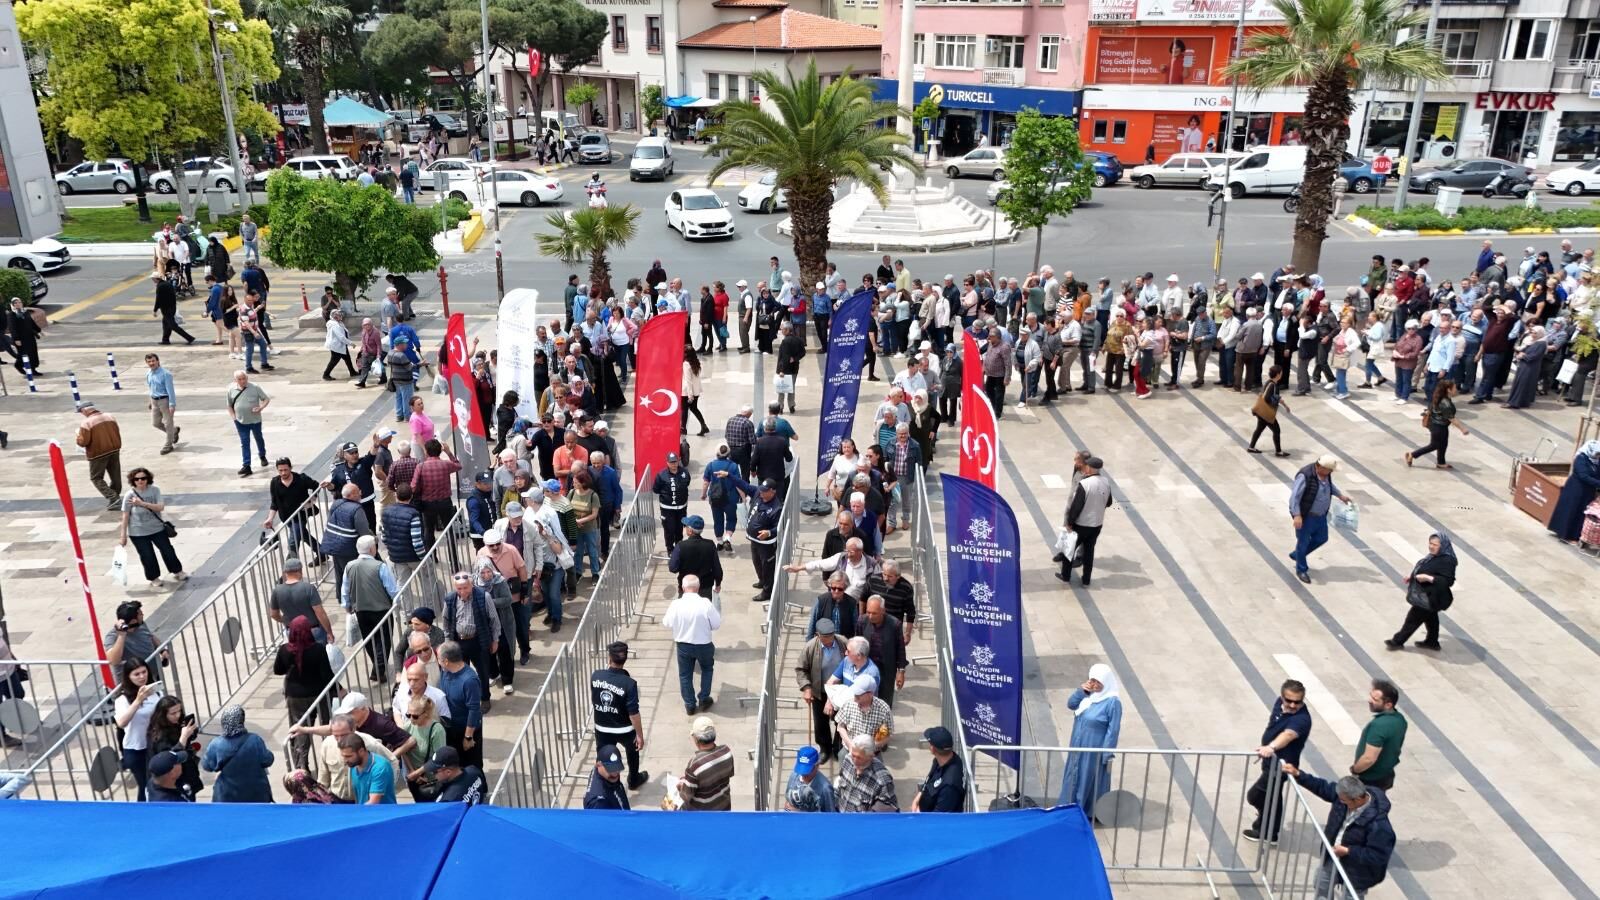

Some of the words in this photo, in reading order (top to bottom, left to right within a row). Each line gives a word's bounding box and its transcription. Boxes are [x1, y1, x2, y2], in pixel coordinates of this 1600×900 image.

[1100, 49, 1134, 58] Bitmeyen
[946, 89, 996, 104] TURKCELL
[1193, 97, 1217, 107] ING
[1474, 92, 1556, 111] EVKUR
[1373, 161, 1391, 169] DUR
[950, 544, 1013, 559] BÜYÜKŞEHİR
[977, 541, 999, 549] AYDIN
[953, 607, 1013, 622] BÜYÜKŞEHİR
[956, 664, 1013, 684] BÜYÜKŞEHİR
[594, 703, 619, 714] ZABITA
